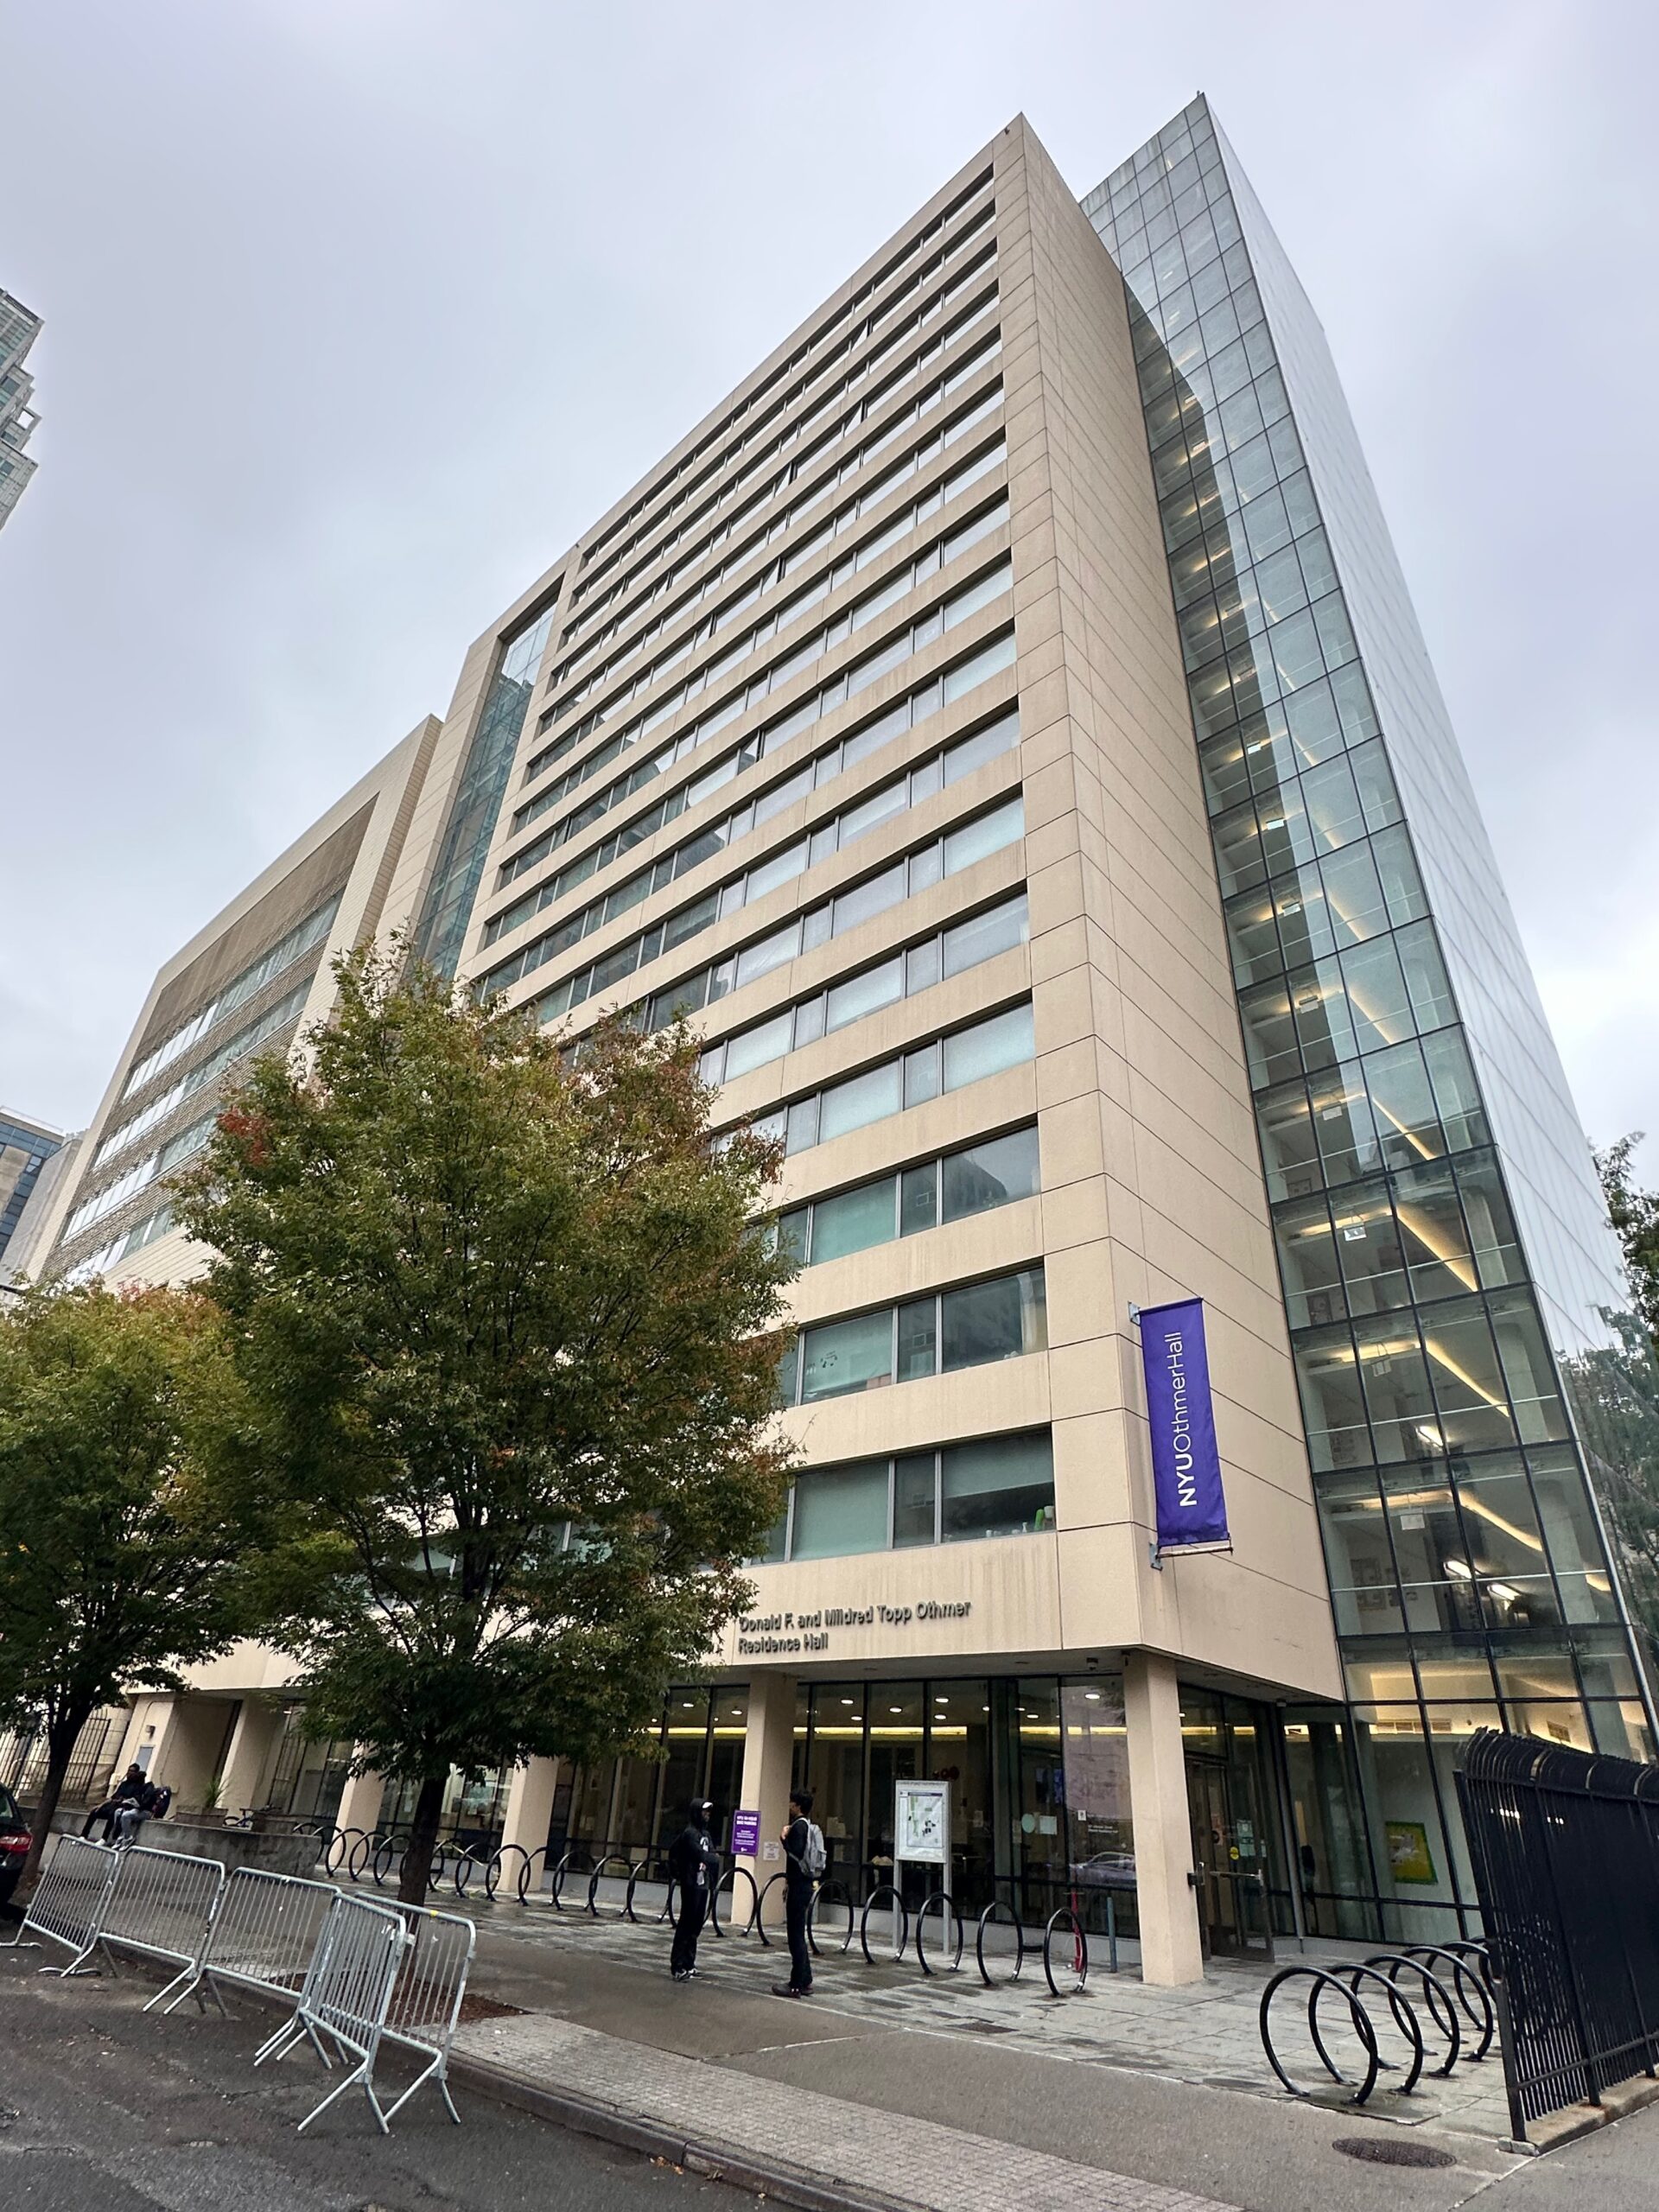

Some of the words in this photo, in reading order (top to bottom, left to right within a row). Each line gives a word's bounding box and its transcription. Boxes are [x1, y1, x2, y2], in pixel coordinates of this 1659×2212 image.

[738, 1613, 782, 1632] Donald
[785, 1611, 795, 1629] F.
[798, 1610, 822, 1629] and
[824, 1605, 874, 1627] Mildred
[876, 1605, 912, 1625] Topp
[916, 1600, 971, 1620] Othmer
[738, 1636, 800, 1654] Residence
[804, 1632, 829, 1651] Hall
